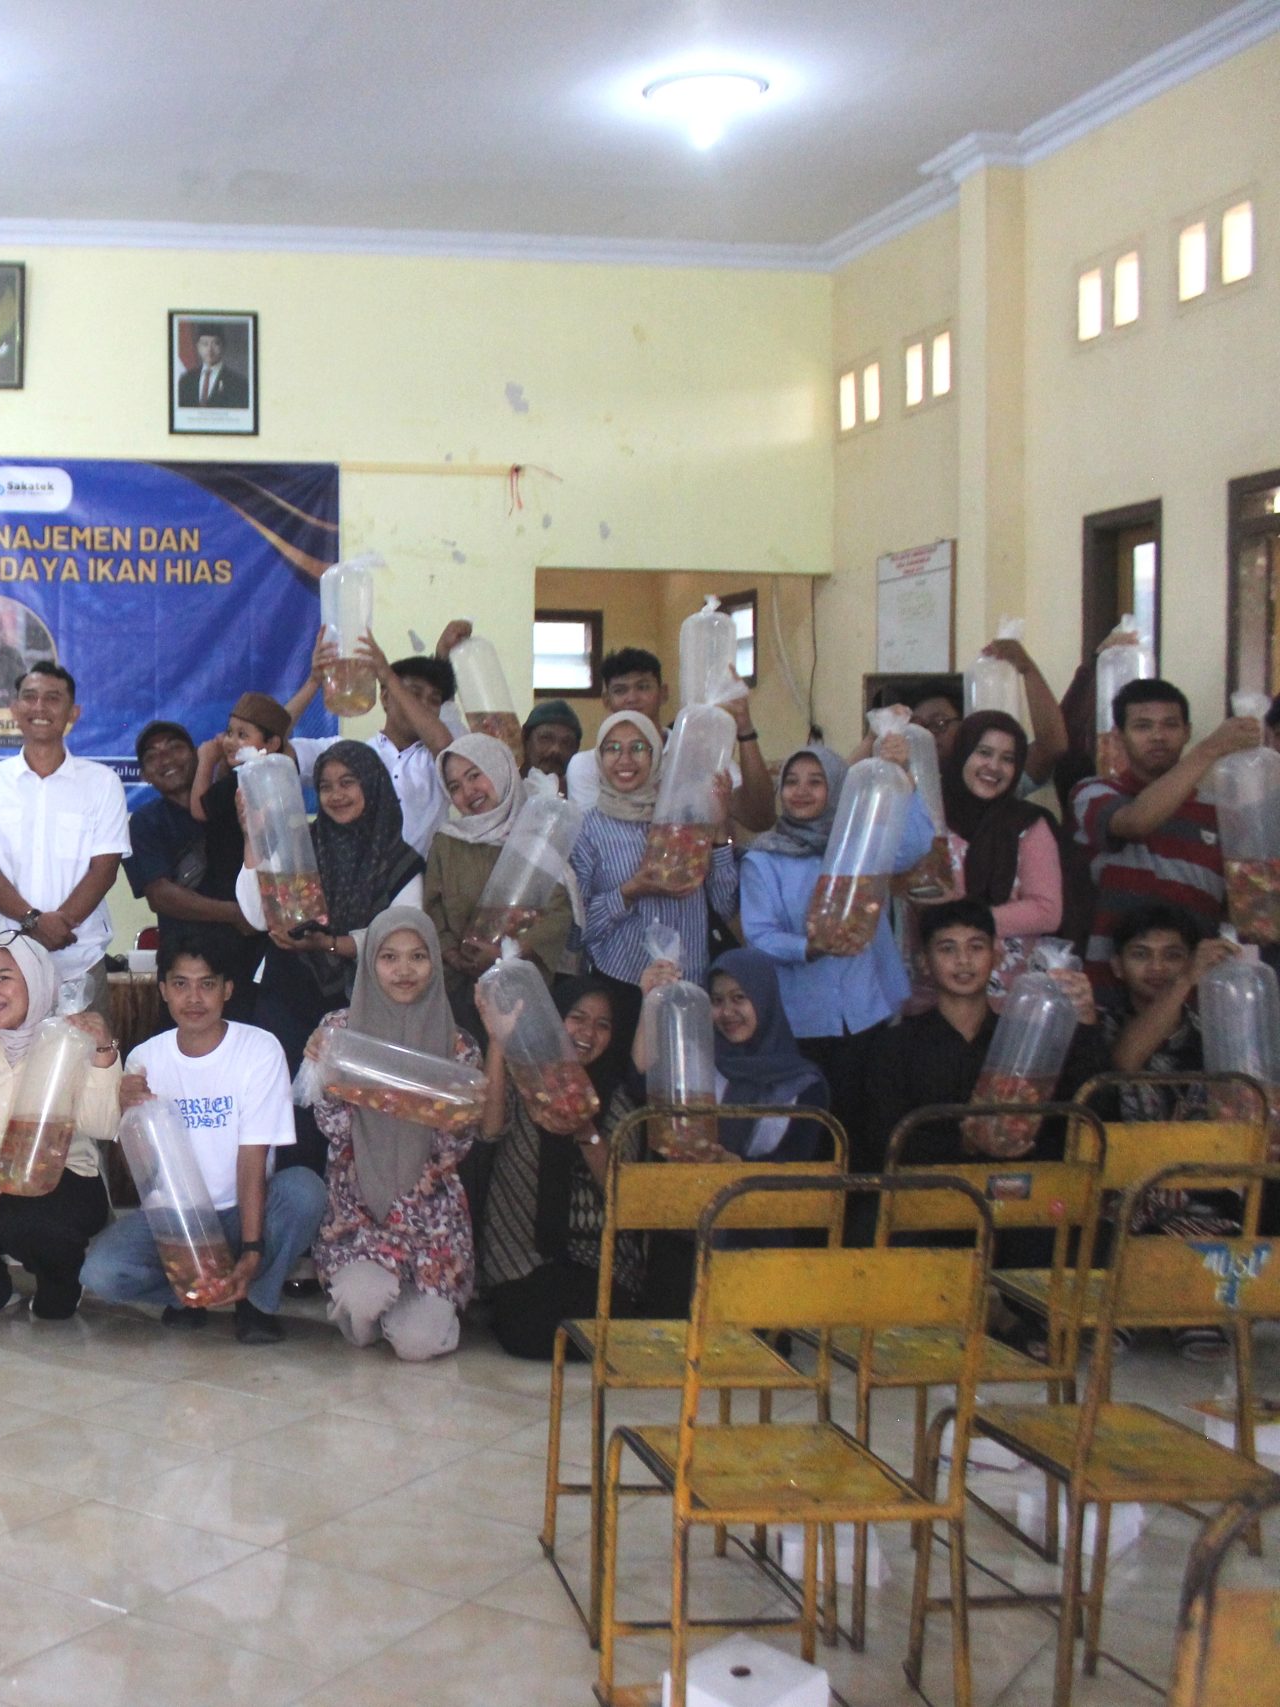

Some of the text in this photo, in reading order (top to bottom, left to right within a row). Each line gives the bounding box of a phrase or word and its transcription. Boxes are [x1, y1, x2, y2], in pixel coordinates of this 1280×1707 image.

[139, 526, 200, 552] DAN
[87, 557, 158, 583] IKAN
[164, 558, 233, 584] HIAS
